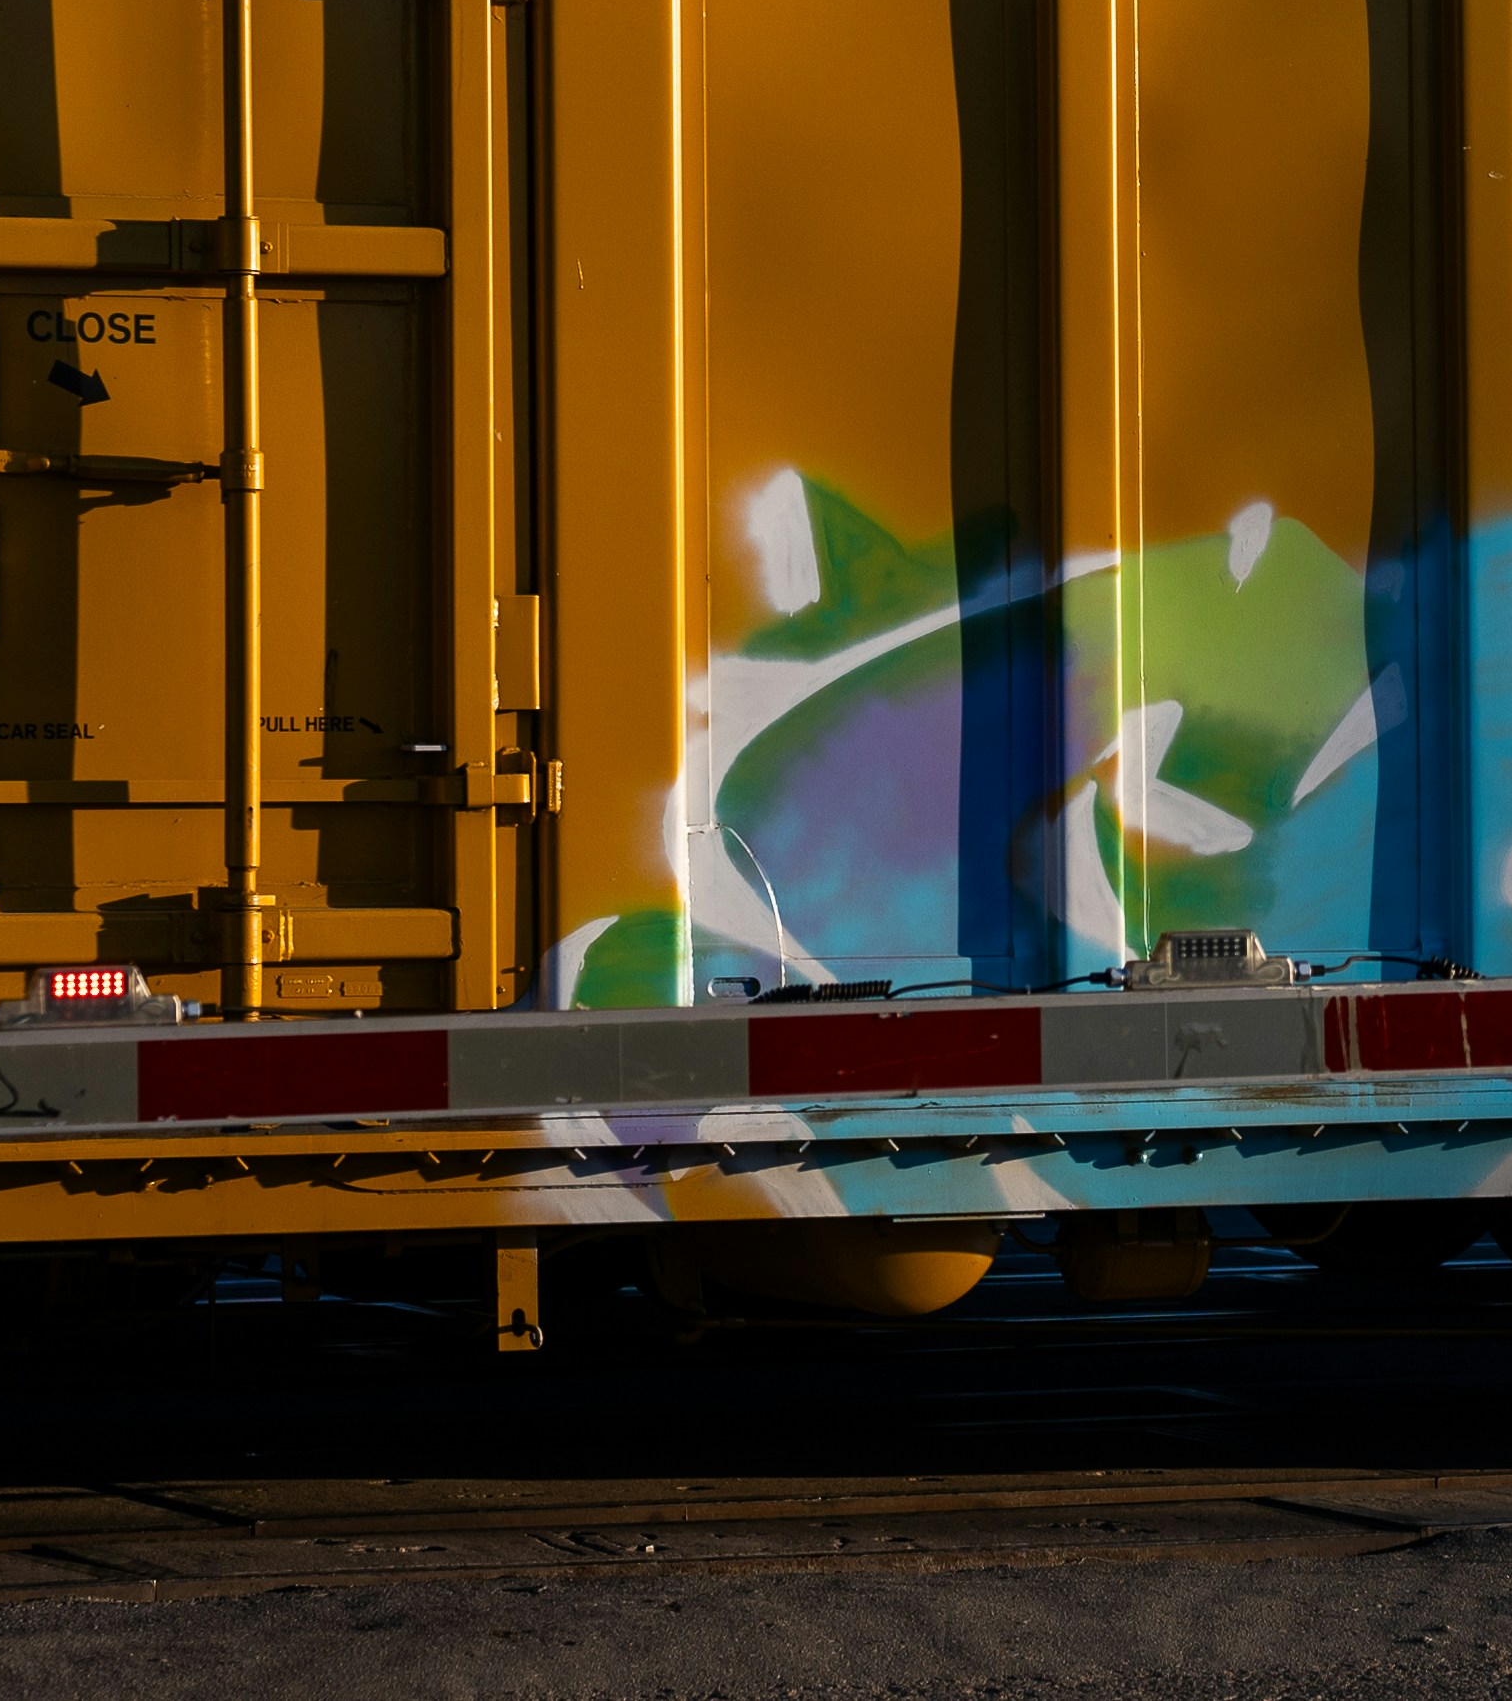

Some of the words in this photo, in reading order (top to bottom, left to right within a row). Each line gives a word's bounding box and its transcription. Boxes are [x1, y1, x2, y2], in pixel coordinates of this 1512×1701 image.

[27, 310, 157, 344] CLOSE
[43, 723, 95, 740] SEAL
[310, 716, 354, 732] HERE
